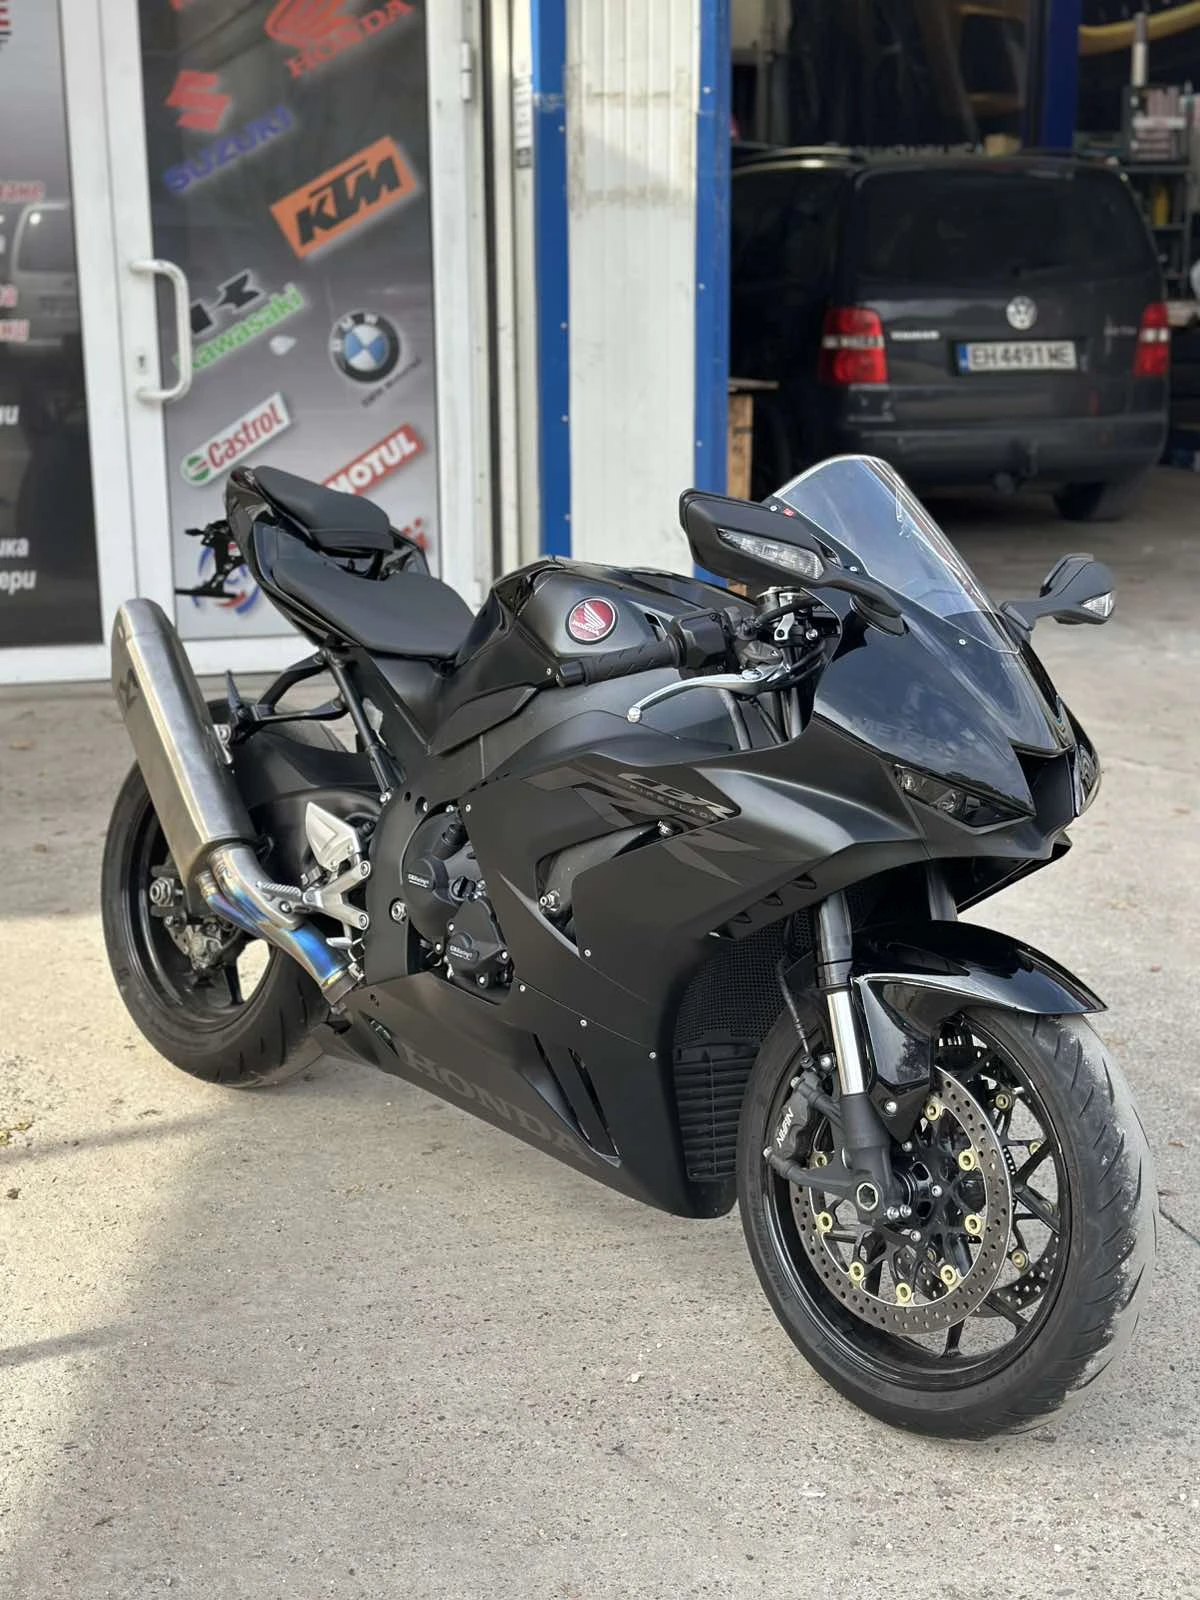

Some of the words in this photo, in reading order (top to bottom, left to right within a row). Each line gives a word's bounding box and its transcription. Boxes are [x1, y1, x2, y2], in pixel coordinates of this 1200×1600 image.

[282, 0, 415, 80] HONDA
[163, 104, 294, 195] SUZUKI
[296, 156, 402, 246] KTM
[207, 402, 283, 469] Castrol
[617, 772, 736, 820] CBR
[401, 1041, 599, 1167] HONDA
